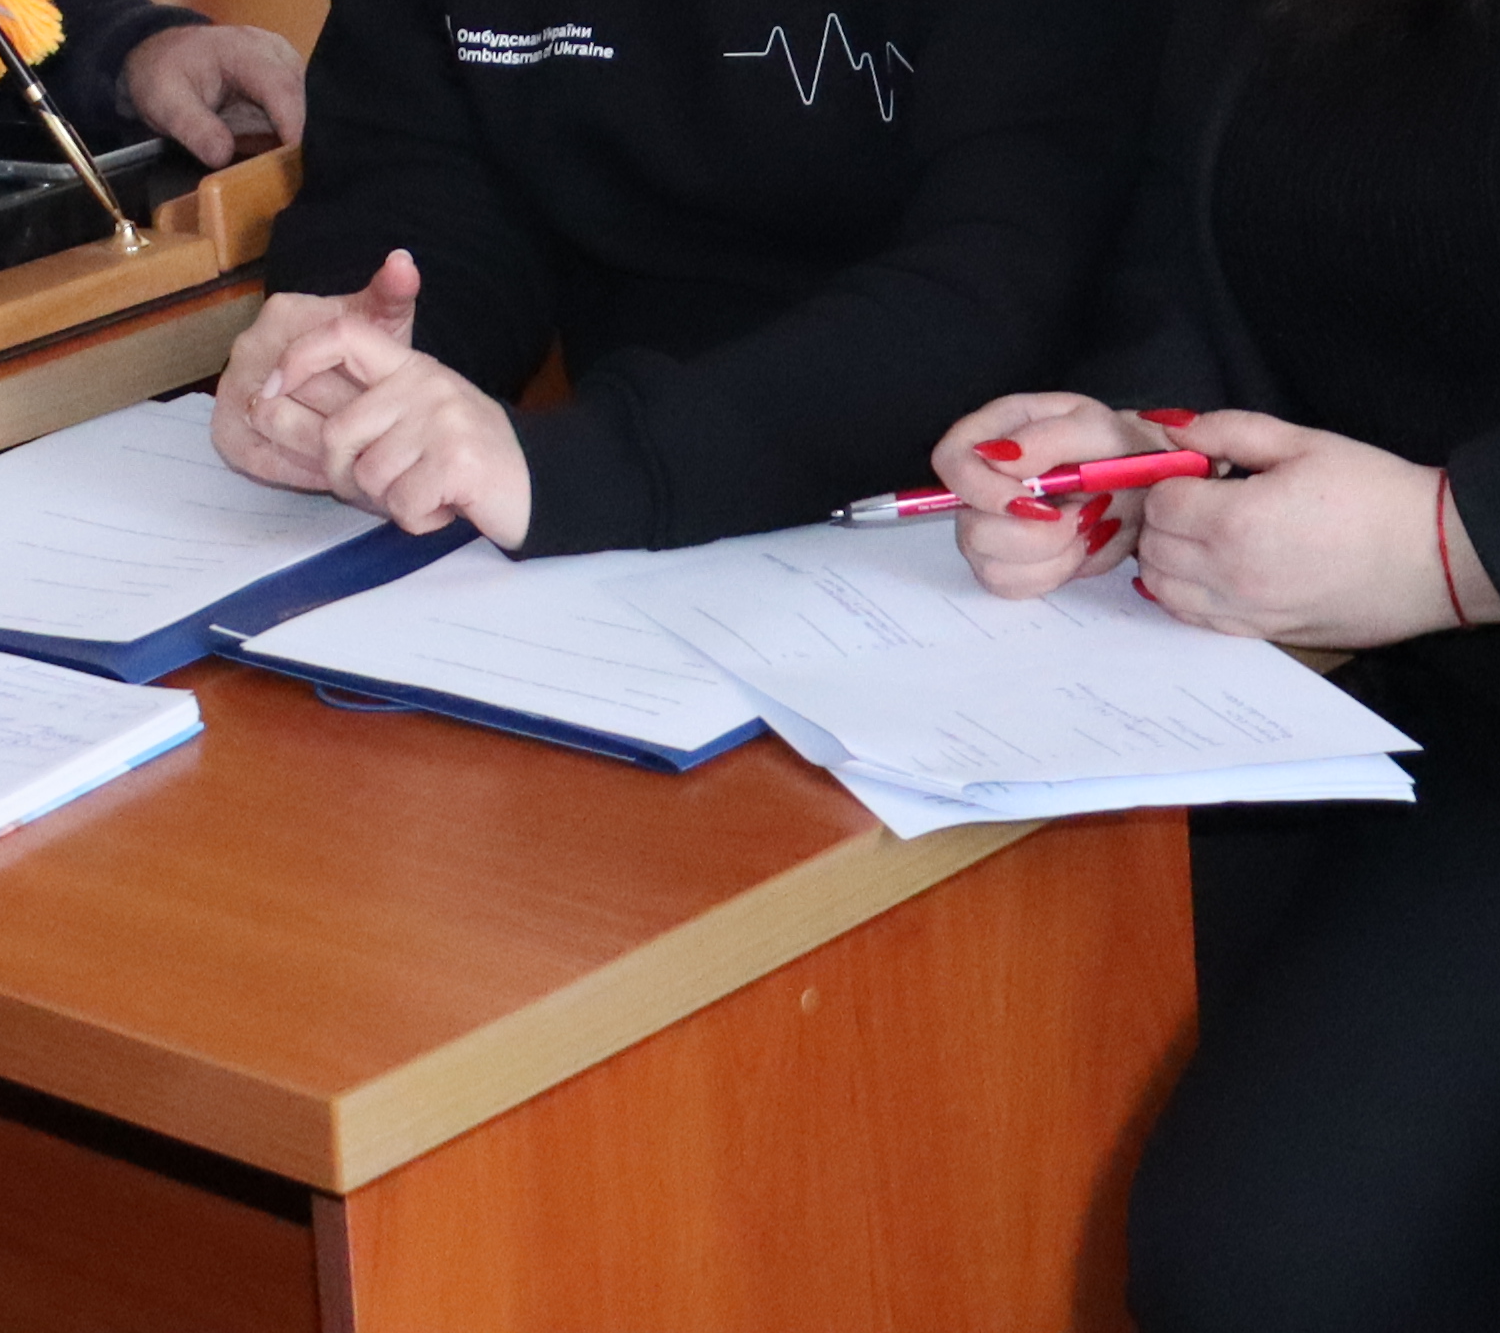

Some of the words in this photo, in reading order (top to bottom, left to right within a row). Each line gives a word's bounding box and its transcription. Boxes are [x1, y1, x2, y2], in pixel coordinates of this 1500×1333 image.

[457, 28, 542, 48] Омбудсман
[458, 47, 543, 65] Ombudsman
[553, 40, 615, 59] Ukraine
